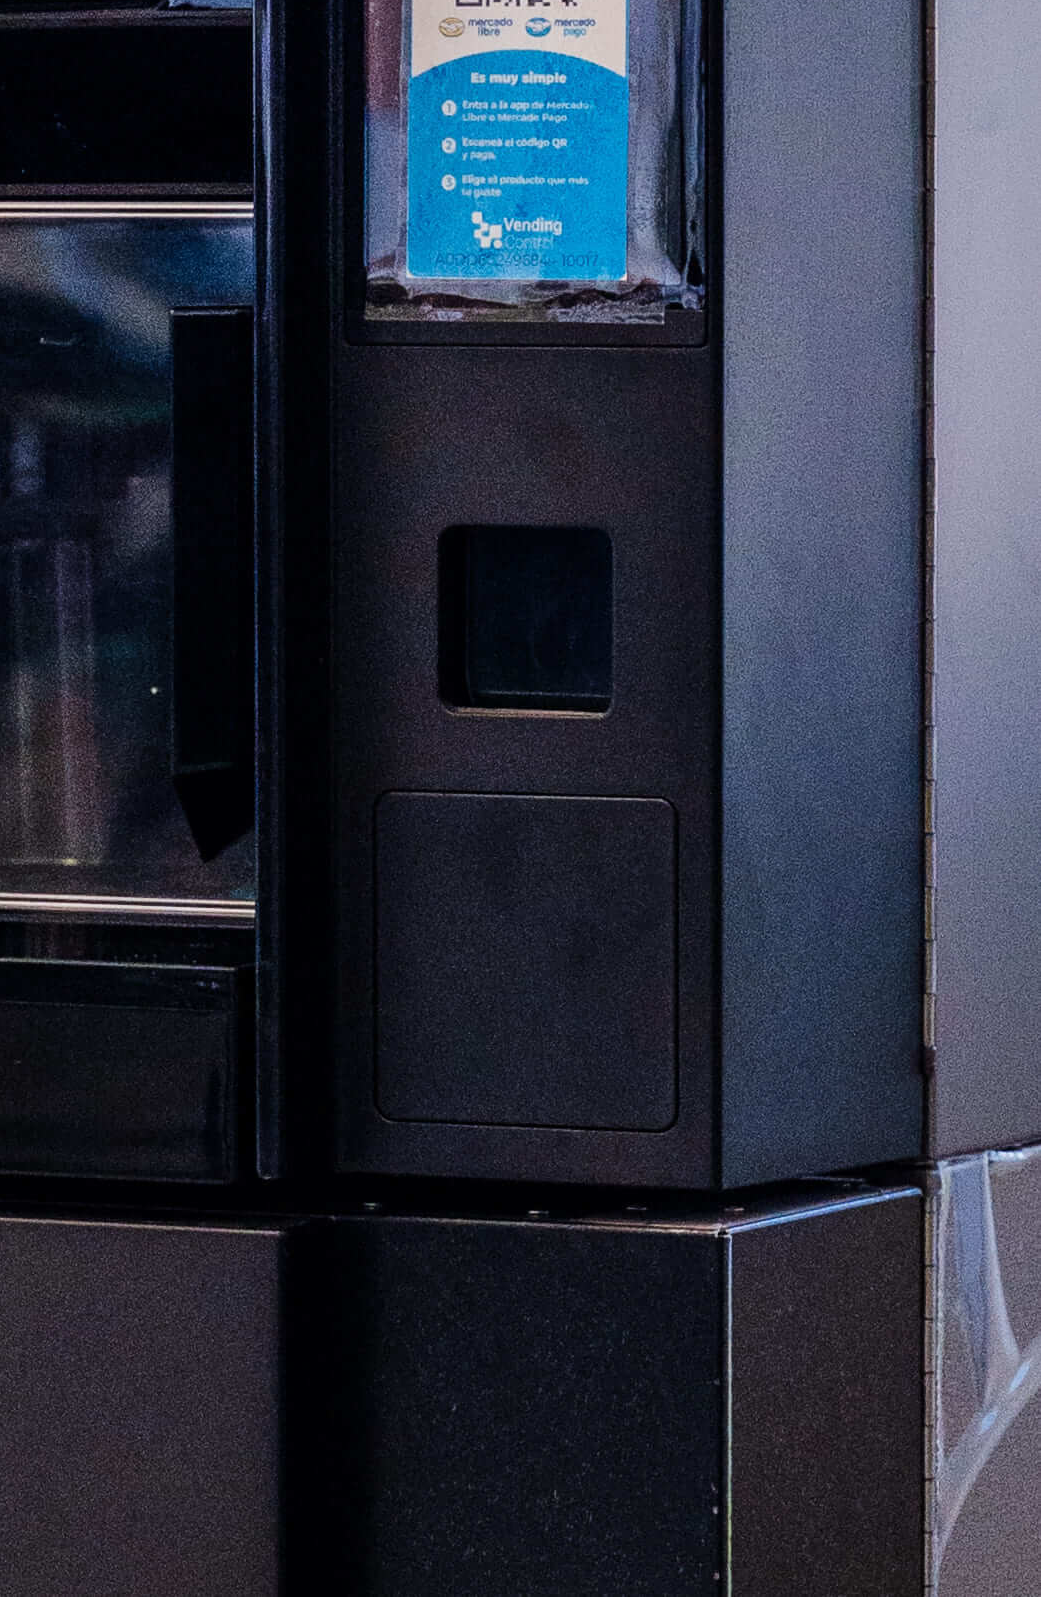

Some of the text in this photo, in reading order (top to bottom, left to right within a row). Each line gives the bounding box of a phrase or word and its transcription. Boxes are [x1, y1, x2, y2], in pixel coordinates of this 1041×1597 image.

[468, 17, 513, 27] mercado
[555, 17, 596, 27] mercado
[471, 71, 567, 86] Es muy simple
[552, 138, 567, 149] QR
[503, 217, 562, 235] Vending
